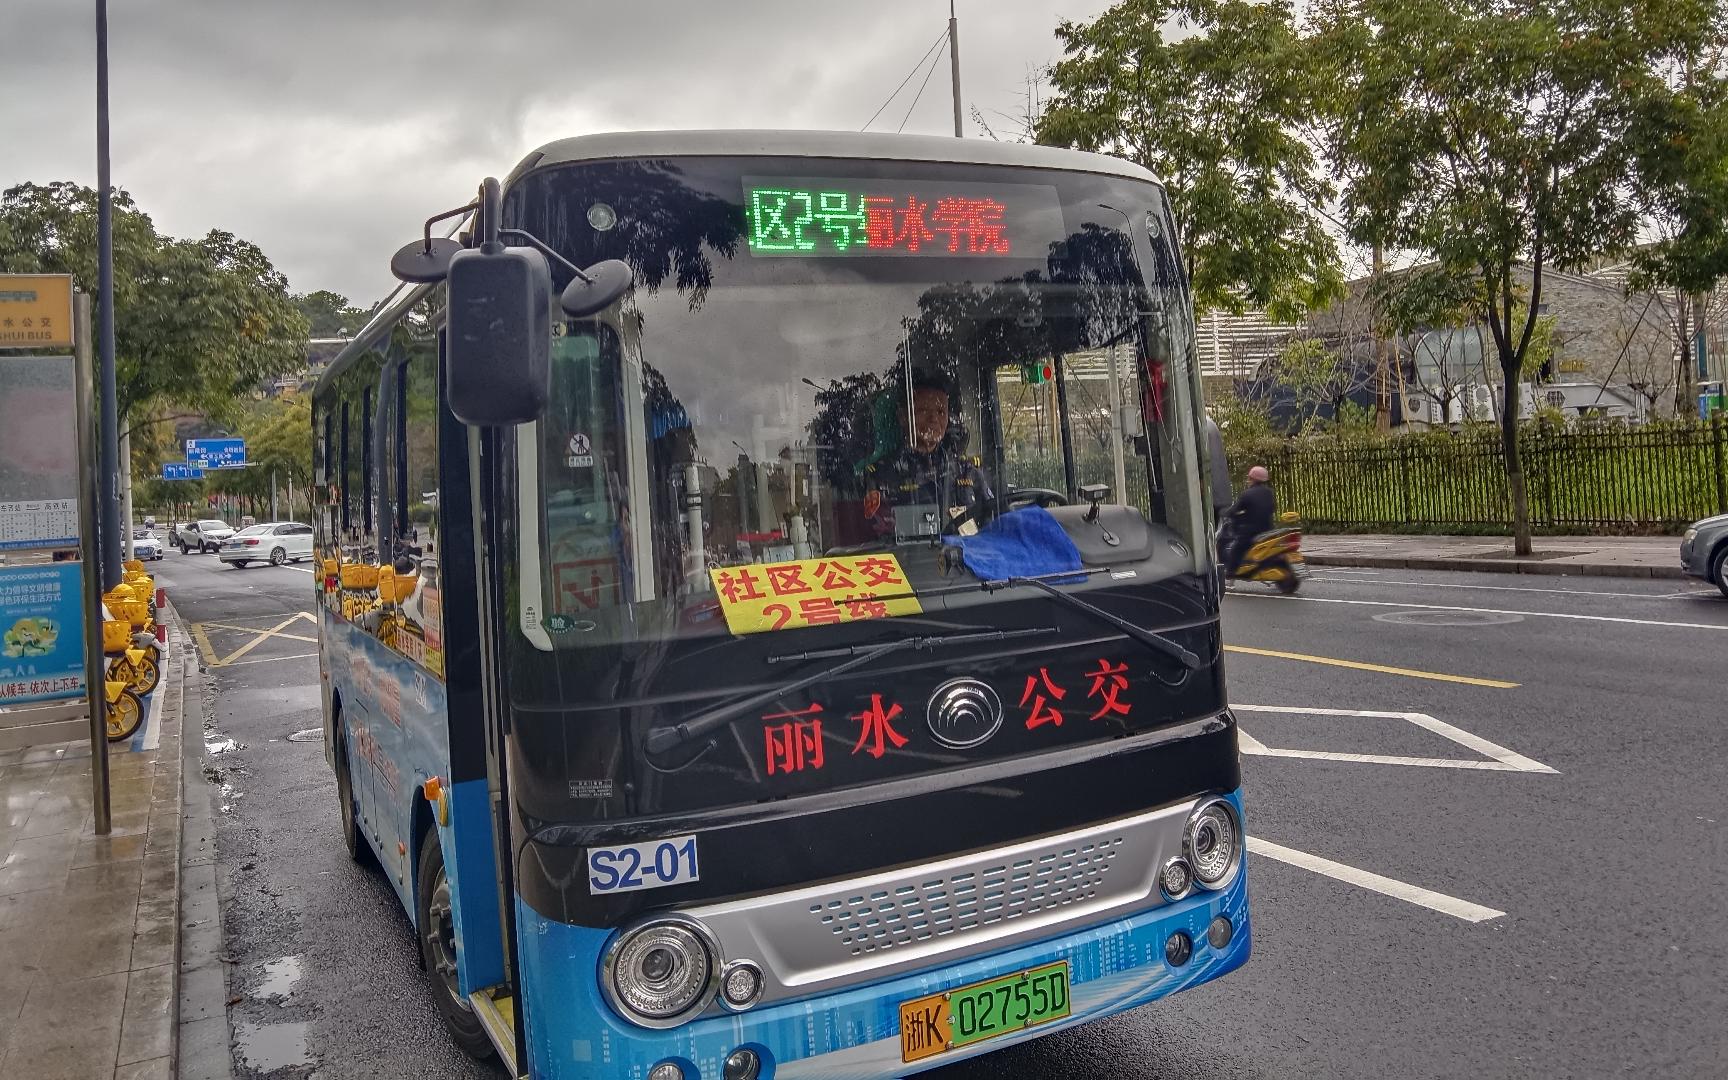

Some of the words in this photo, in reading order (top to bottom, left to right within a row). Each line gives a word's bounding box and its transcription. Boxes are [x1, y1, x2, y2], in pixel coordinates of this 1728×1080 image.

[28, 331, 52, 340] BUS
[718, 557, 903, 604] 社区公交
[761, 693, 909, 776] 丽水
[1018, 658, 1133, 731] 公交
[590, 838, 697, 891] S2-01
